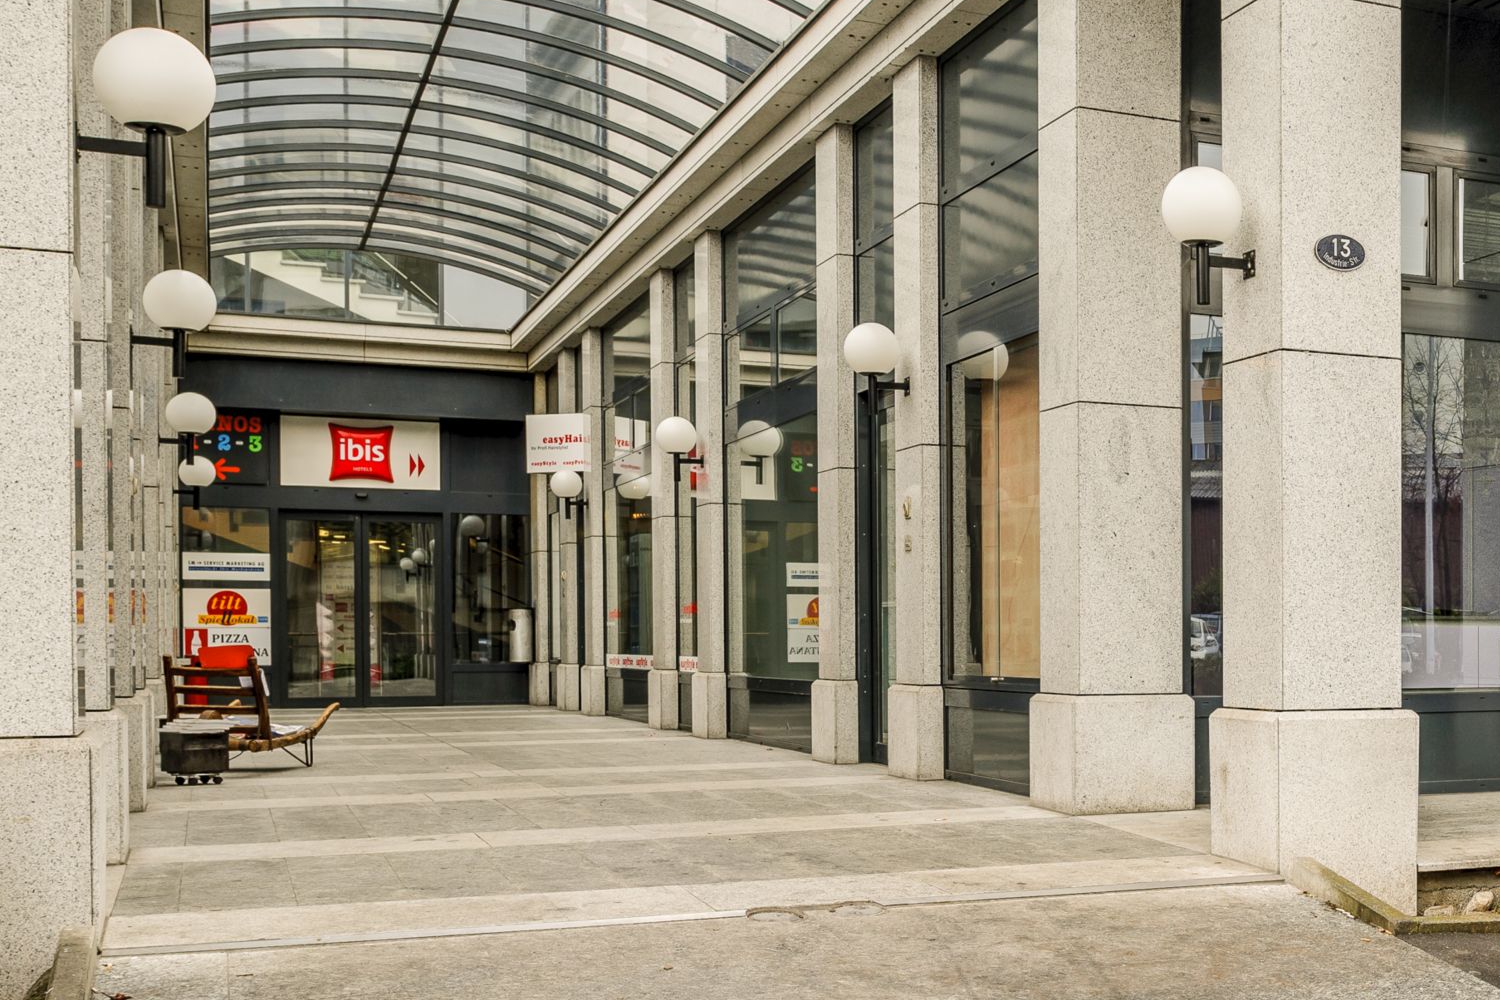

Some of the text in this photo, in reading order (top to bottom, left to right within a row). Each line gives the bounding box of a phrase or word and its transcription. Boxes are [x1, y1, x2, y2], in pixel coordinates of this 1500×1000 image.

[1332, 238, 1351, 258] 13
[339, 437, 385, 462] ibis
[211, 595, 242, 610] tilt
[212, 633, 250, 644] PIZZA
